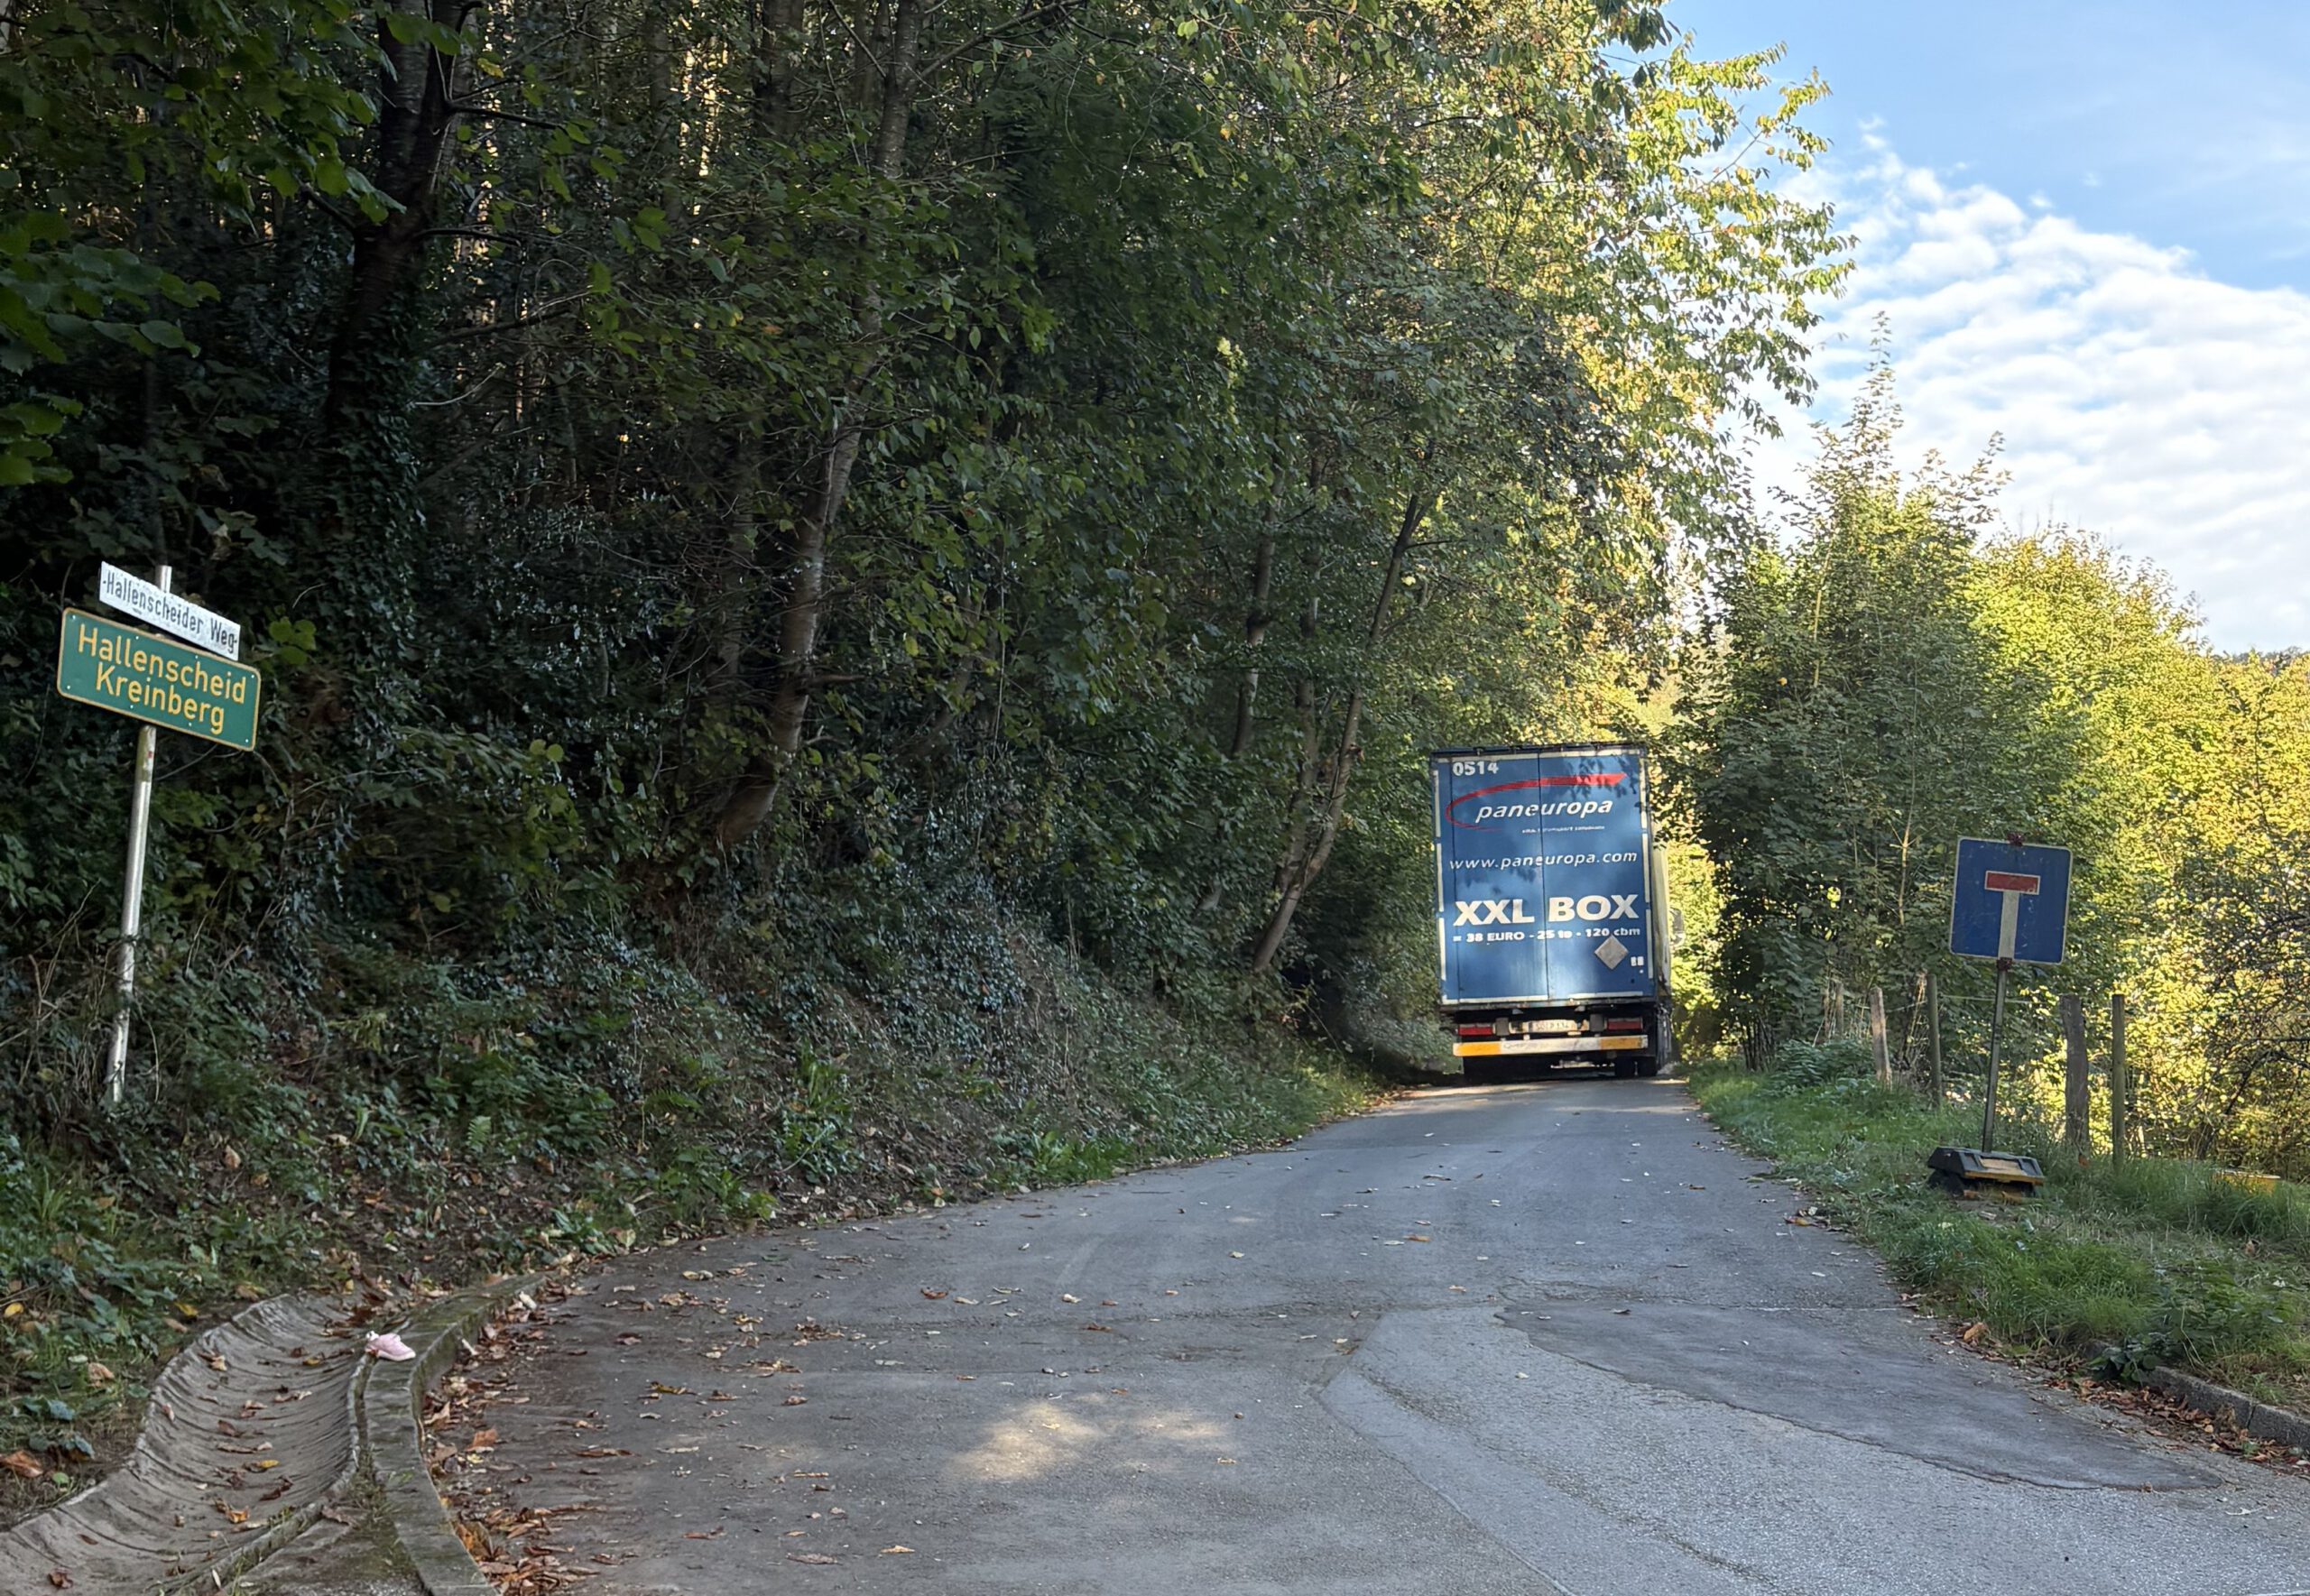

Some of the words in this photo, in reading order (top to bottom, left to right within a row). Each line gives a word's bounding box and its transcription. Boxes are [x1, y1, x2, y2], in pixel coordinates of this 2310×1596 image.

[79, 623, 246, 704] Hallenscheid
[96, 661, 225, 735] Kreinberg
[1452, 761, 1499, 776] 0514
[1475, 799, 1613, 823] paneuropa
[1449, 851, 1637, 870] www.paneuropa.com
[1453, 899, 1535, 927] XXL
[1548, 894, 1640, 922] BOX
[1466, 933, 1483, 943] 38
[1487, 931, 1525, 942] EURO
[1537, 929, 1556, 939] 25
[1585, 927, 1610, 937] 120
[1613, 927, 1640, 936] cbm
